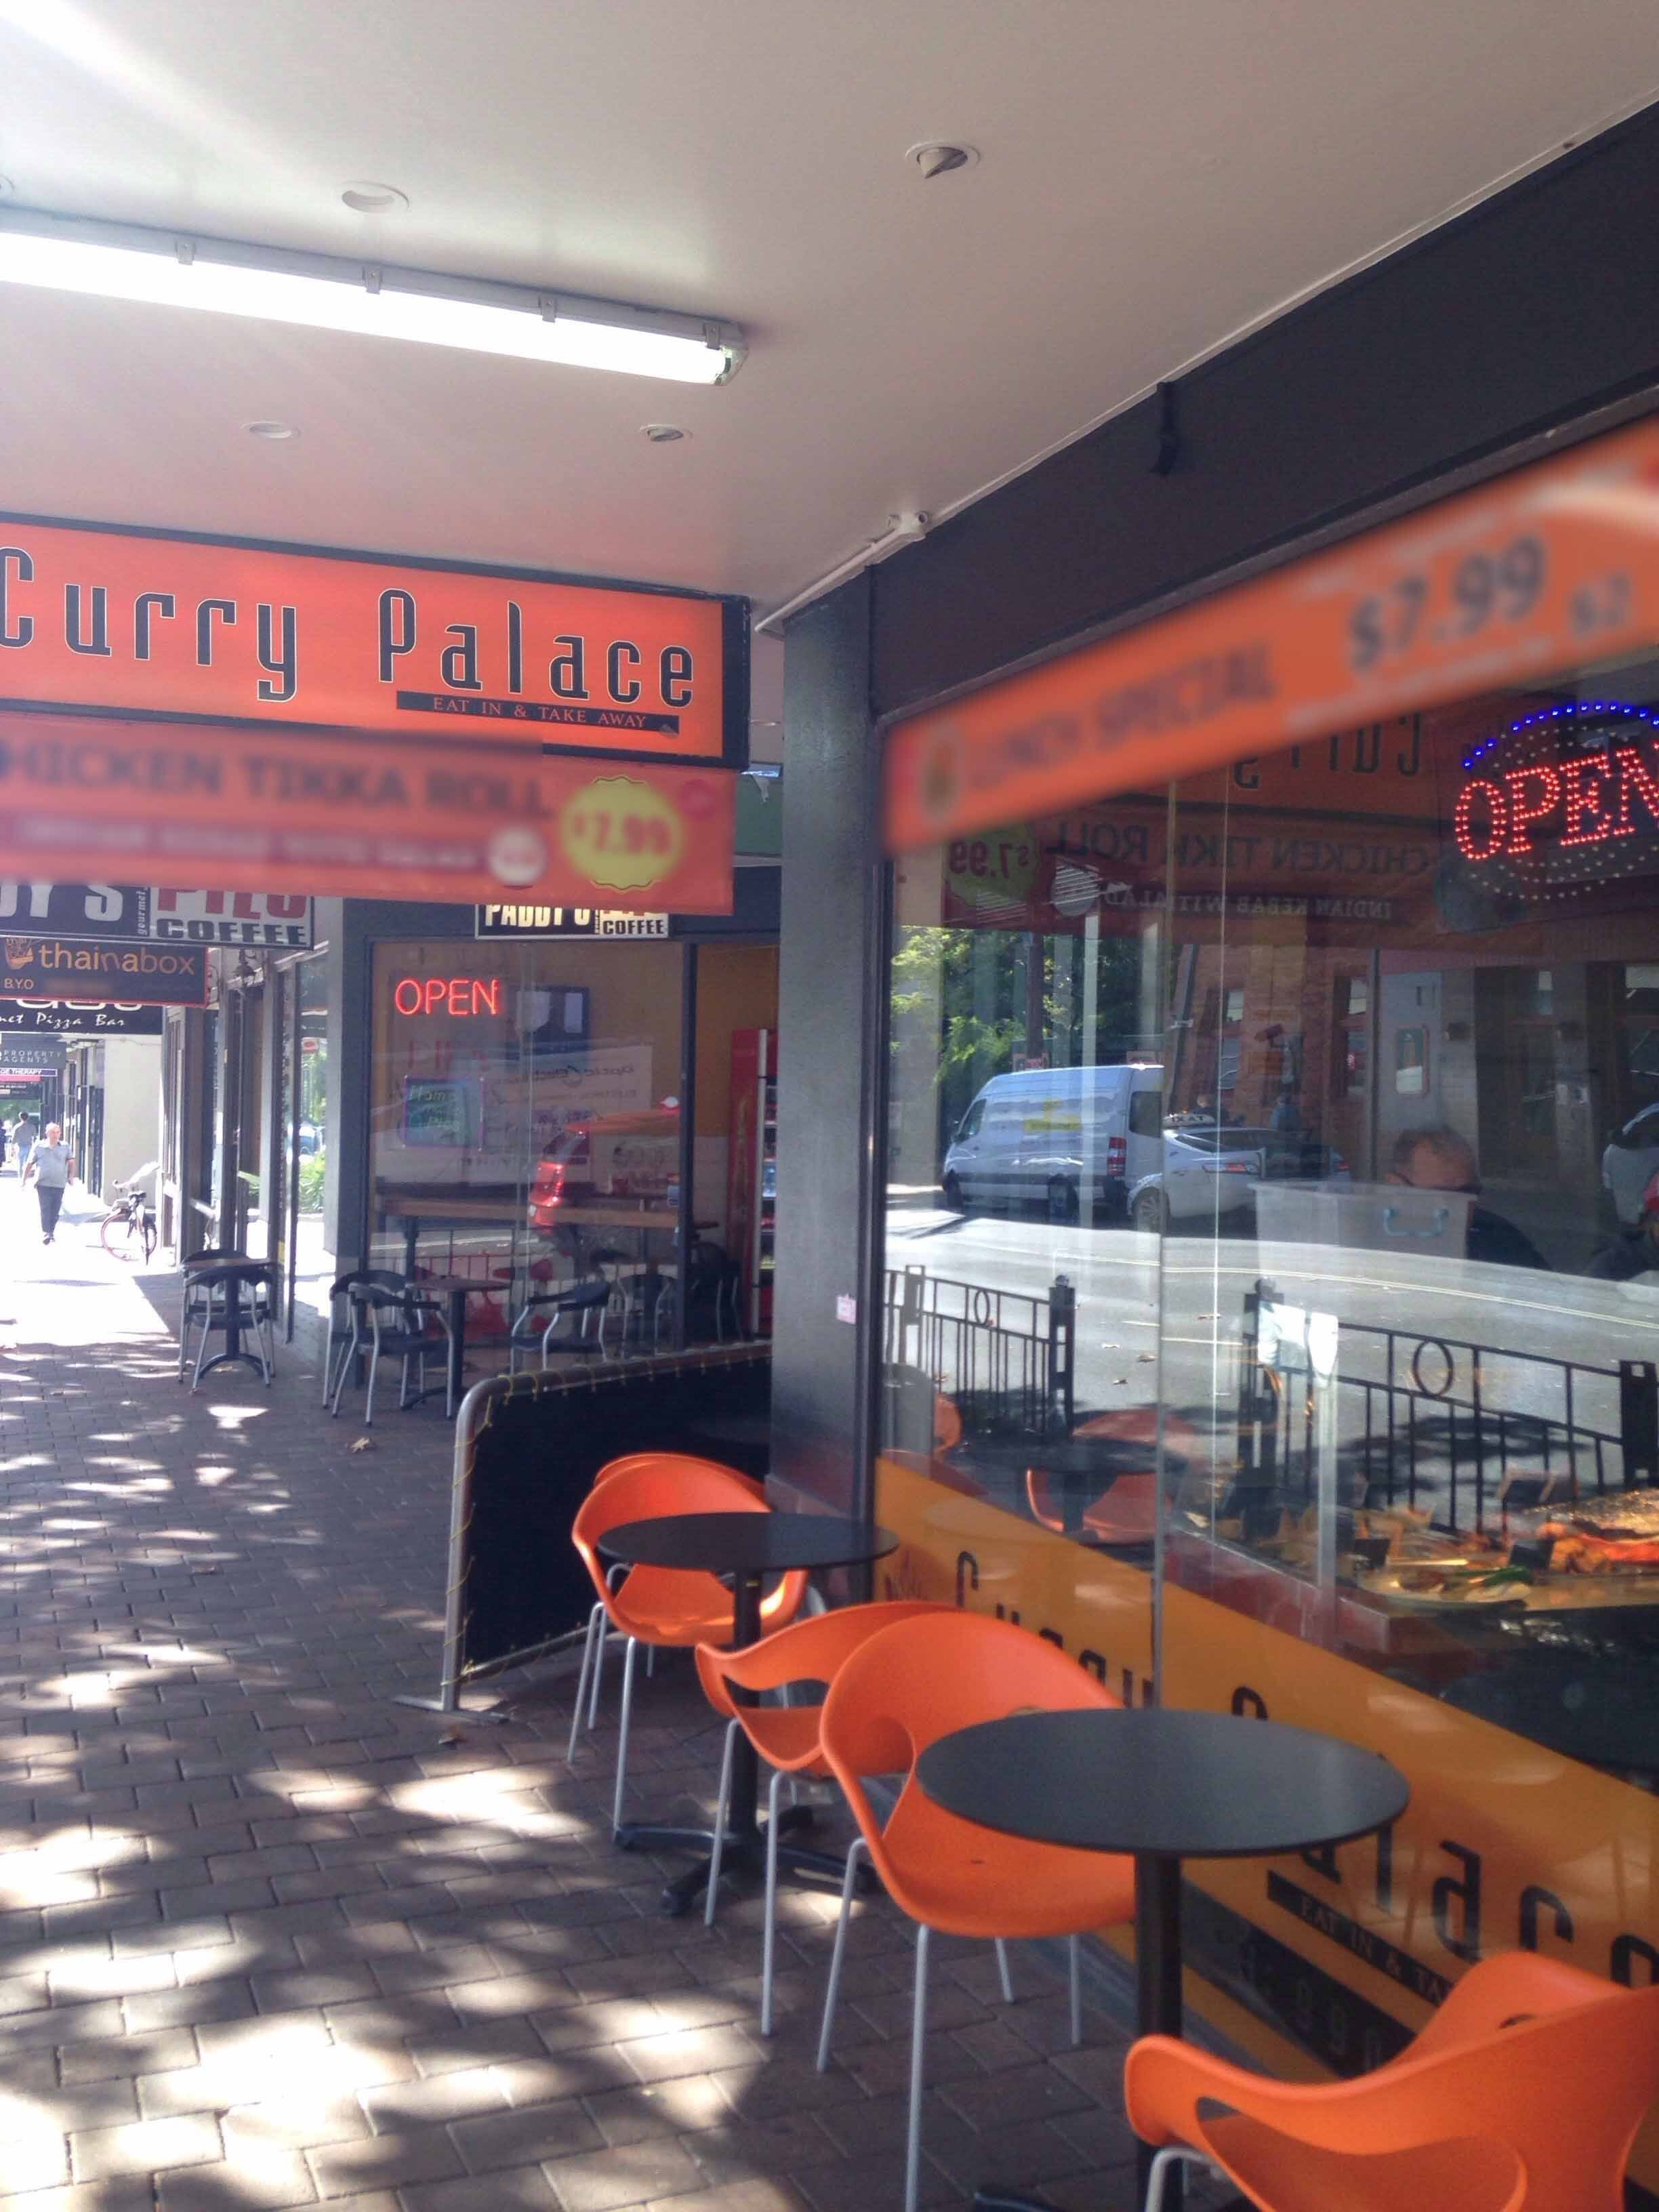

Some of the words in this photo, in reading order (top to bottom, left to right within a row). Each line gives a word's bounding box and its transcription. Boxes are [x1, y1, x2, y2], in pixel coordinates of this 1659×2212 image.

[0, 547, 297, 703] Curry
[378, 588, 694, 708] Palace
[433, 697, 470, 712] EAT
[482, 701, 501, 716] IN
[514, 704, 527, 717] &
[539, 706, 586, 723] TAKE
[598, 714, 647, 729] AWAY
[1454, 740, 1659, 859] OPEN
[136, 890, 148, 936] gourmet
[602, 920, 664, 935] COFFEE
[157, 919, 305, 944] COFFEE
[38, 943, 196, 975] thainabox
[395, 979, 499, 1015] OPEN
[36, 1012, 83, 1029] Pizza
[96, 1014, 125, 1026] Bar
